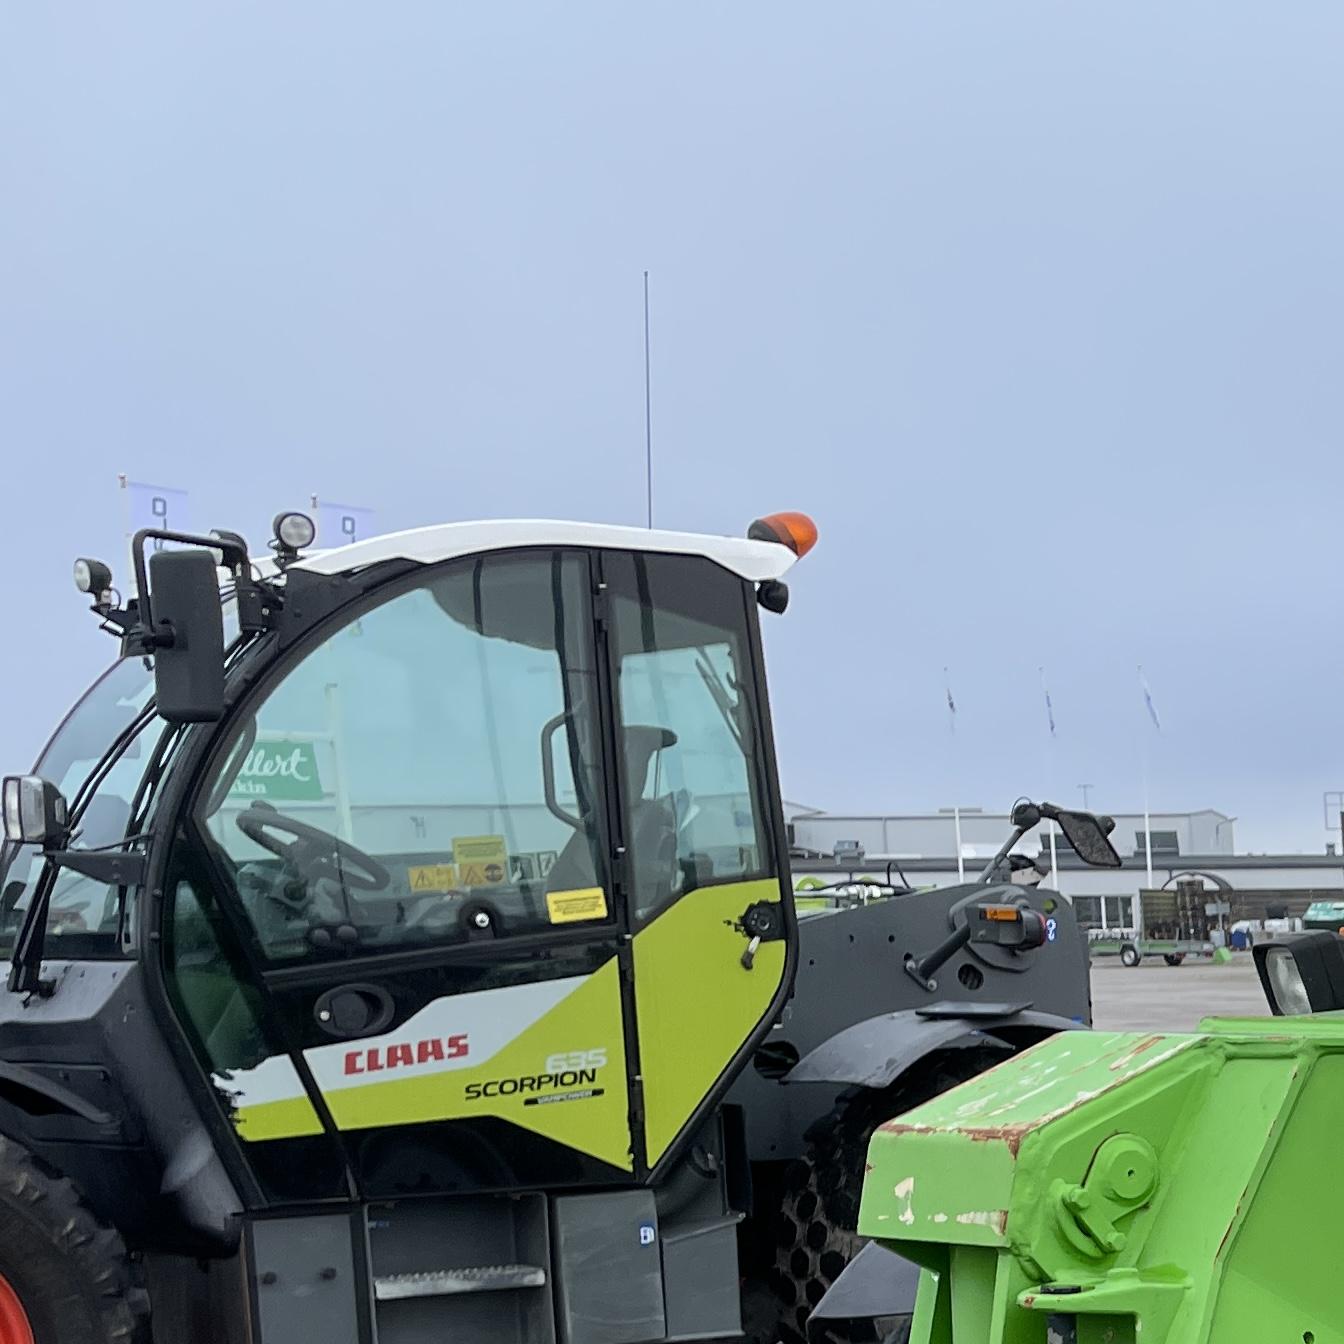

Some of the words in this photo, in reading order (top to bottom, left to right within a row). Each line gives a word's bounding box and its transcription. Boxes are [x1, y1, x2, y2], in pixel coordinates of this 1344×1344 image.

[344, 1034, 469, 1075] CLAAS
[545, 1048, 607, 1074] 635
[465, 1068, 597, 1100] SCORPION
